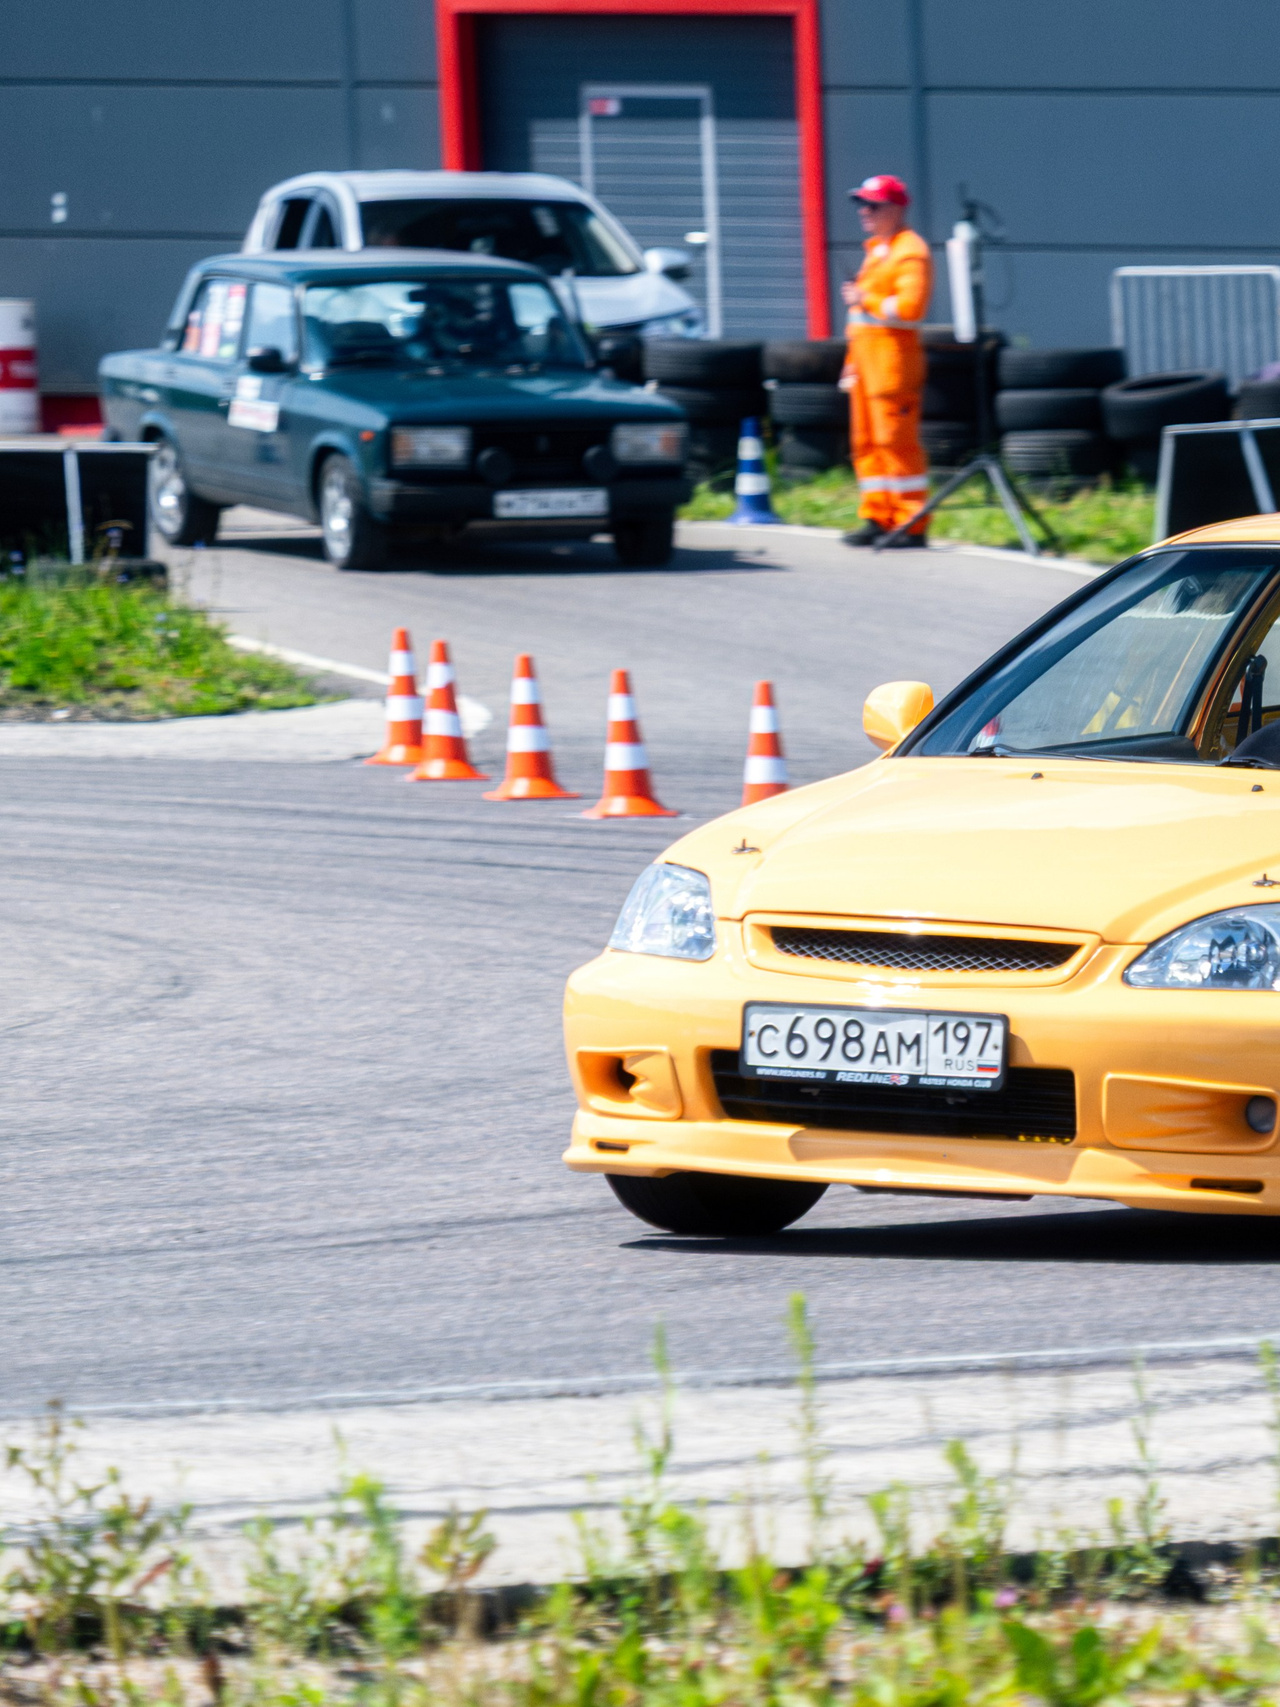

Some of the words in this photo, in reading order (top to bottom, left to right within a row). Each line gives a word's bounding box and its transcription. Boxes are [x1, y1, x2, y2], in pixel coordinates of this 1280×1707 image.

[933, 1021, 993, 1057] 197
[944, 1058, 975, 1071] RUS
[836, 1071, 910, 1086] REDLINERS
[946, 1079, 973, 1087] HONDA
